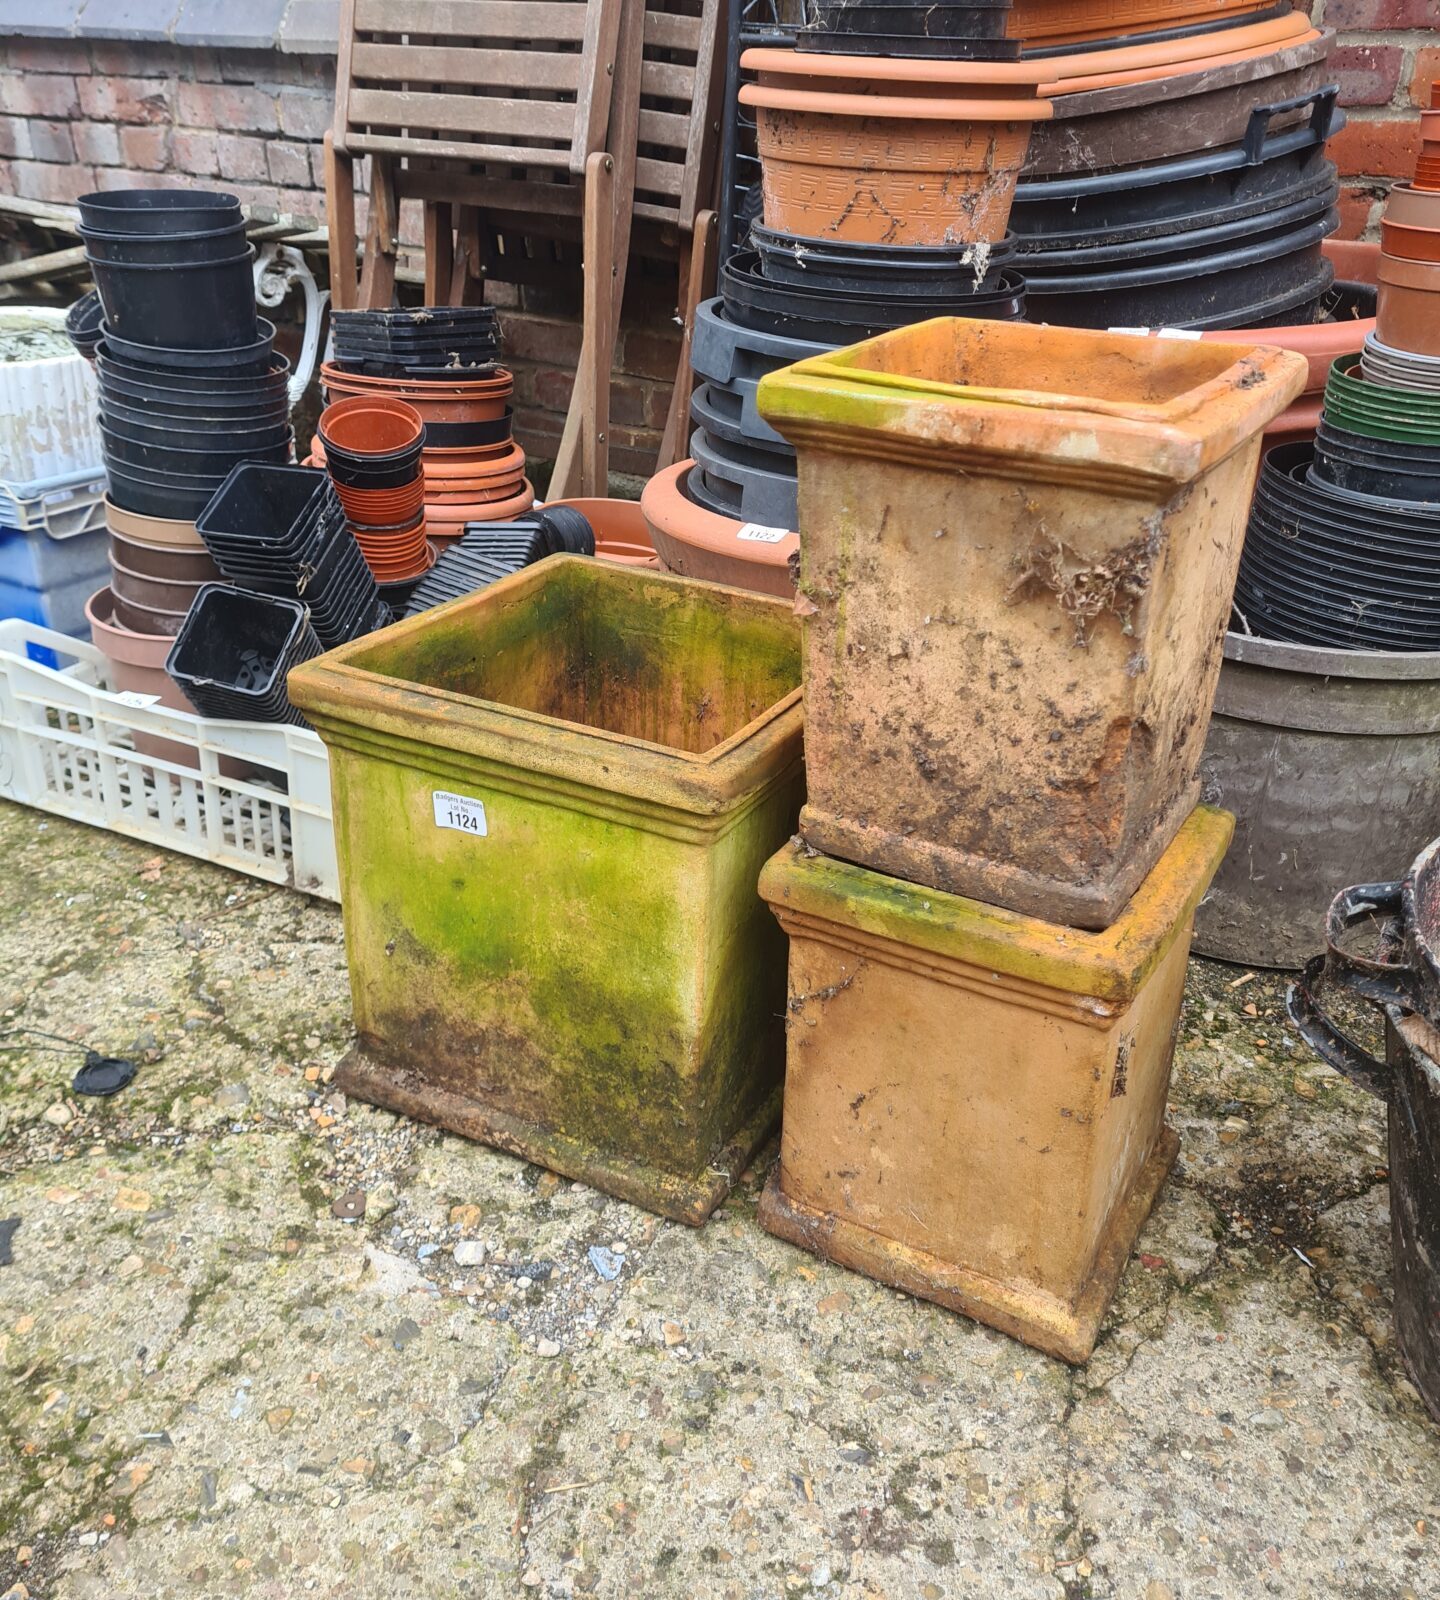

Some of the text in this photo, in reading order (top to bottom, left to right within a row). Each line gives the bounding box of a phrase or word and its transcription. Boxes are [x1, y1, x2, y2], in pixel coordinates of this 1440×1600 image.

[435, 793, 483, 809] Badgers Auctions
[450, 803, 460, 811] Lot
[447, 811, 478, 831] 1124
